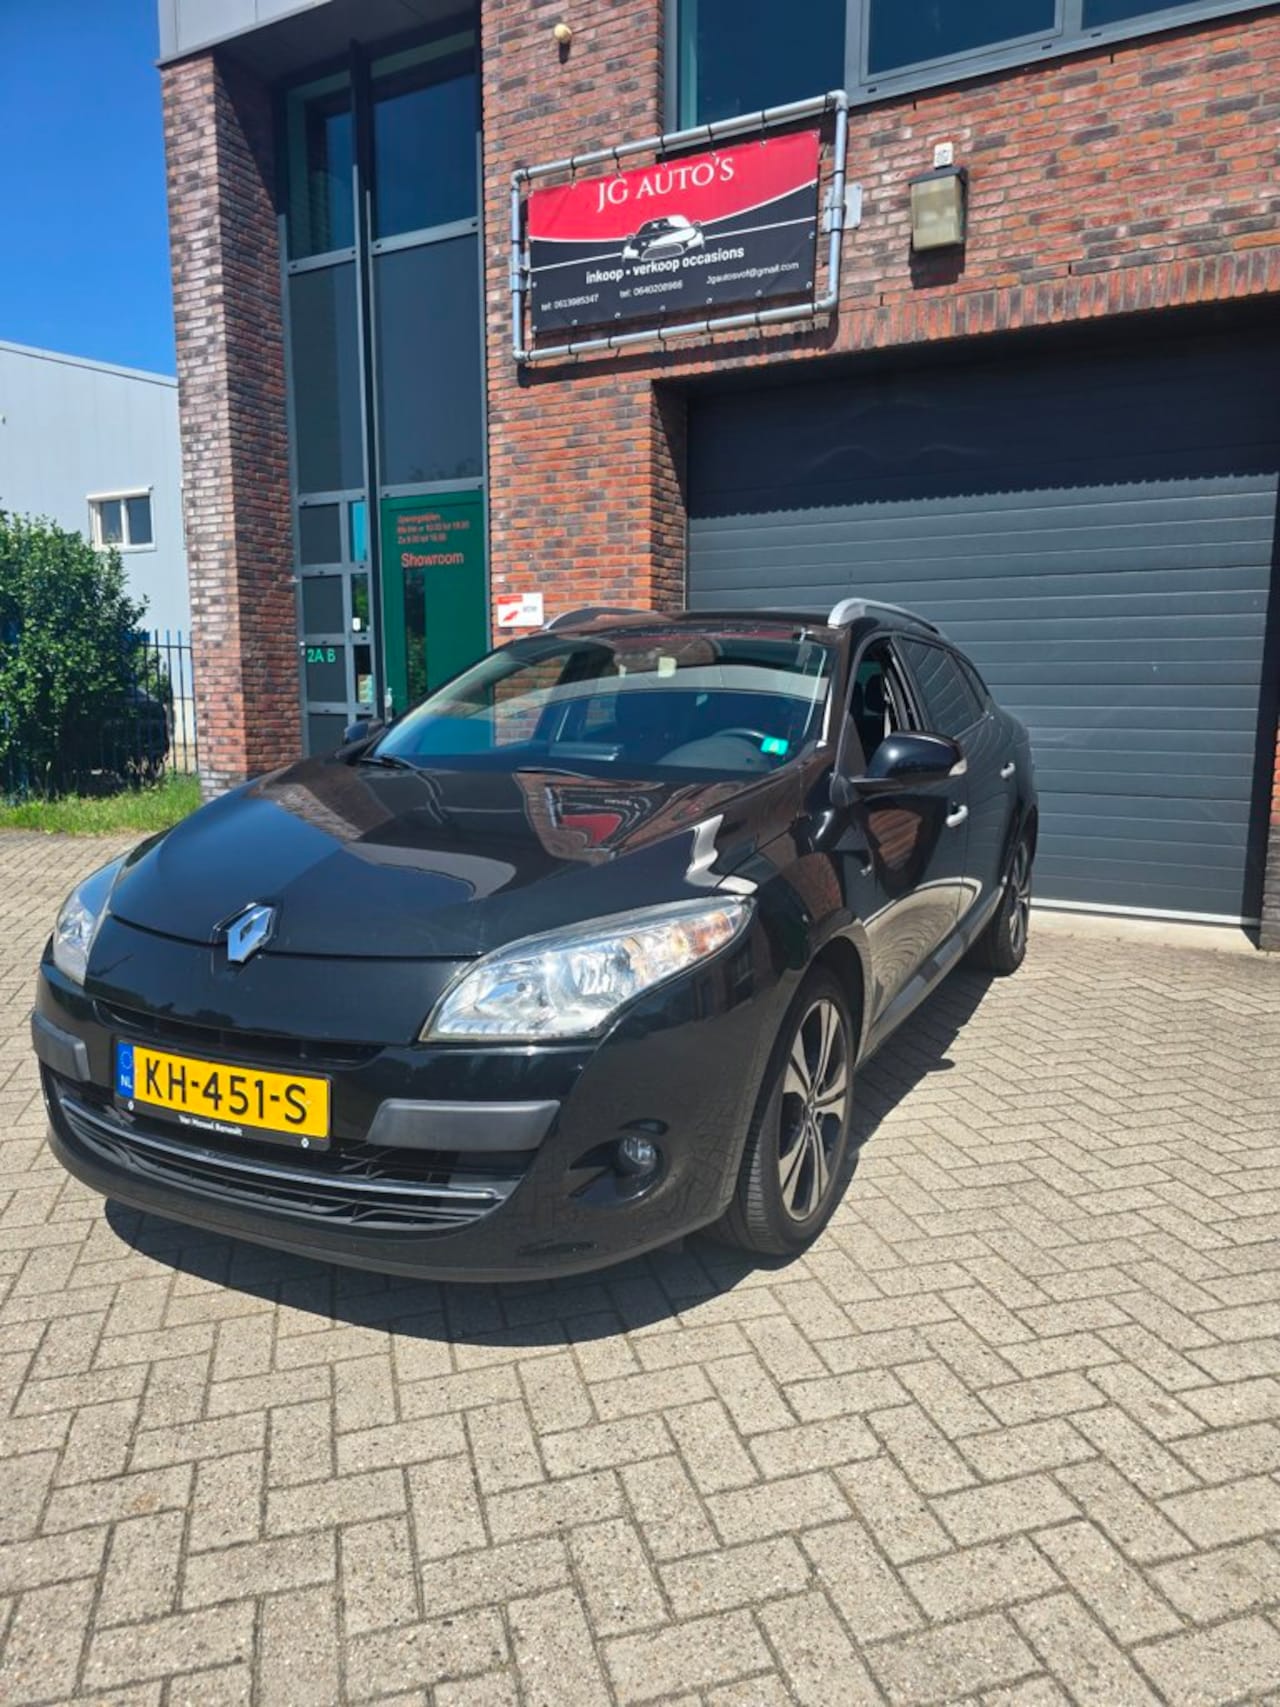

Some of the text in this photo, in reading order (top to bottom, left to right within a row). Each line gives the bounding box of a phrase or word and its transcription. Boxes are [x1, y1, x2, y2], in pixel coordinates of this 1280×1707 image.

[597, 157, 734, 213] JG AUTO'S
[585, 246, 745, 284] inkoop verkoop occasions
[401, 553, 465, 568] Showroom
[307, 648, 325, 663] 2A
[120, 1074, 133, 1089] NL
[145, 1057, 307, 1125] KH-451-S
